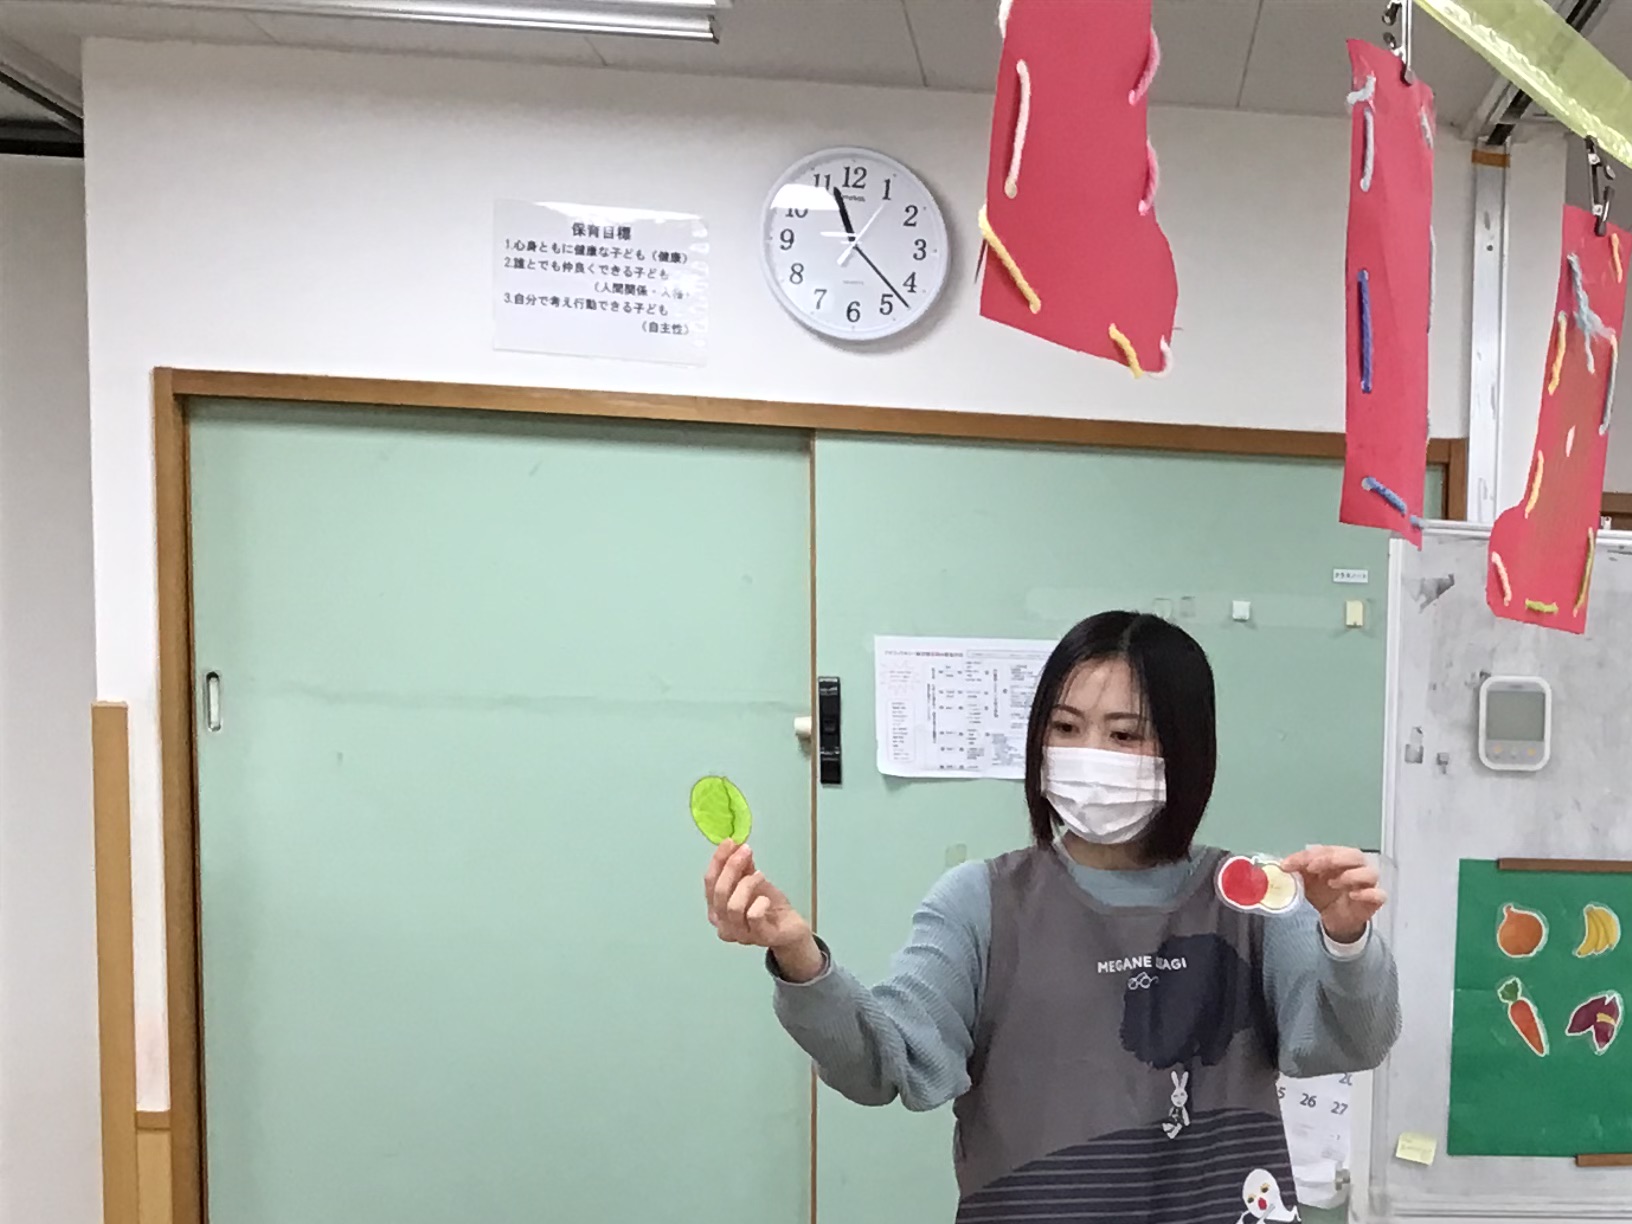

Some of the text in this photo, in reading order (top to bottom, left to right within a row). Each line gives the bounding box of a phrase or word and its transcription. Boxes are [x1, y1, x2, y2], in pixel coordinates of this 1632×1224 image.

[841, 166, 868, 189] 12
[881, 178, 892, 201] 1
[902, 204, 919, 227] 2
[570, 222, 631, 241] 保育目標
[779, 228, 795, 250] 9
[912, 238, 927, 260] 3
[789, 262, 804, 285] 8
[902, 271, 917, 293] 4
[813, 288, 827, 310] 7
[879, 293, 894, 315] 5
[846, 300, 861, 323] 6
[1097, 955, 1153, 974] MEGANE
[1299, 1092, 1318, 1108] 26
[1330, 1100, 1349, 1116] 27
